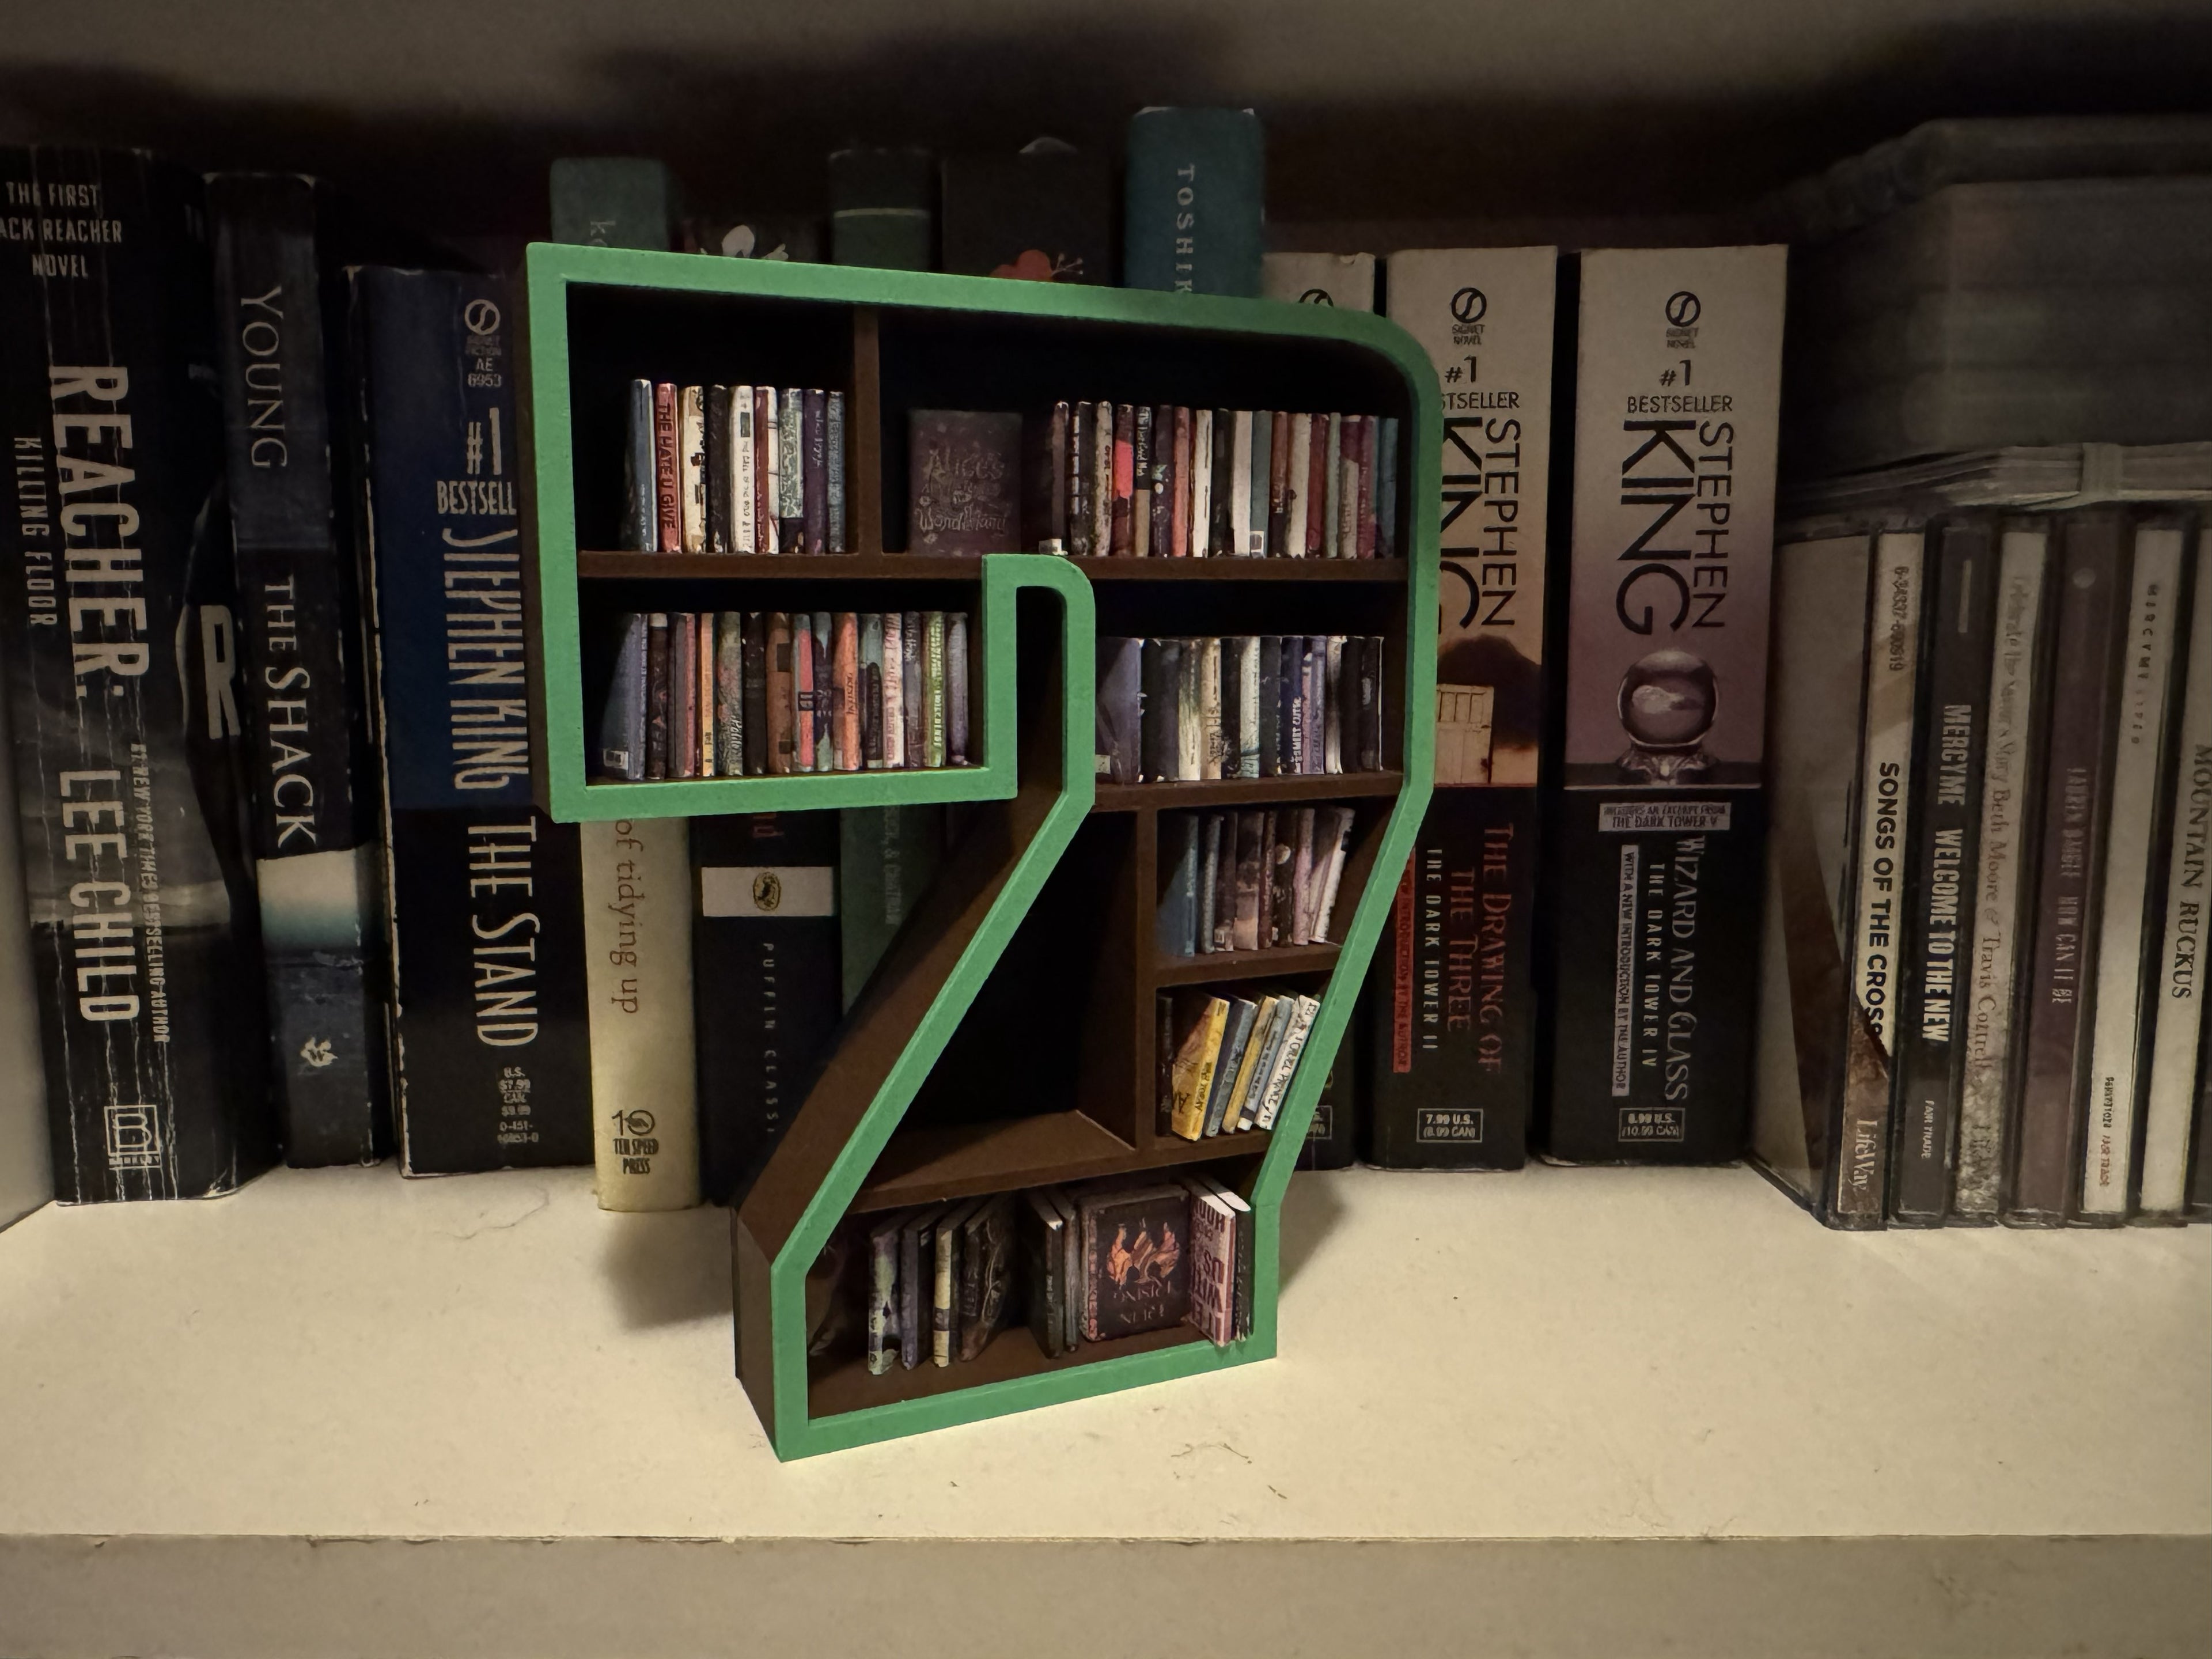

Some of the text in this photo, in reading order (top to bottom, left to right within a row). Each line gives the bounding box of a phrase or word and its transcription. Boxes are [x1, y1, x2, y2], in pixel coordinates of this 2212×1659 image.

[6, 181, 98, 206] THE FIRST
[43, 218, 122, 243] REACHER
[32, 253, 89, 278] NOVEL
[240, 286, 289, 468] YOUNG
[1445, 355, 1478, 383] #1
[1627, 395, 1733, 414] BESTSELLER
[1660, 359, 1692, 387] #1
[466, 406, 502, 476] #1
[14, 436, 58, 627] KILLING FLOOR
[1481, 418, 1521, 626] STEPHEN
[1616, 420, 1696, 635] KING
[1692, 420, 1734, 628] STEPHEN
[200, 603, 241, 740] R
[263, 574, 317, 849] THE SHACK
[1481, 821, 1514, 881] THE
[1874, 762, 1900, 849] SONGS
[59, 770, 140, 1022] LEE CHILD
[467, 816, 537, 900] THE
[1872, 857, 1894, 892] OF
[1922, 704, 1972, 1042] MERCYME WELCOME TO THE NEW
[608, 819, 646, 1015] of tidying up
[1421, 849, 1442, 1050] THE DARK TOWER II
[1446, 867, 1479, 1033] THE THREE
[1478, 893, 1512, 1024] DRAWING
[1869, 899, 1891, 948] THE
[1979, 930, 2003, 990] Travis
[2054, 933, 2077, 961] CAN
[2172, 900, 2200, 999] RUCKUS
[471, 912, 541, 1047] STAND
[762, 942, 777, 1031] PUFFIN
[1641, 862, 1665, 1067] THE DARK TOWER IV
[1663, 834, 1705, 1102] WIZARD AND GLASS
[1453, 1113, 1474, 1124] U.S.
[1851, 1118, 1878, 1192] LifeWay
